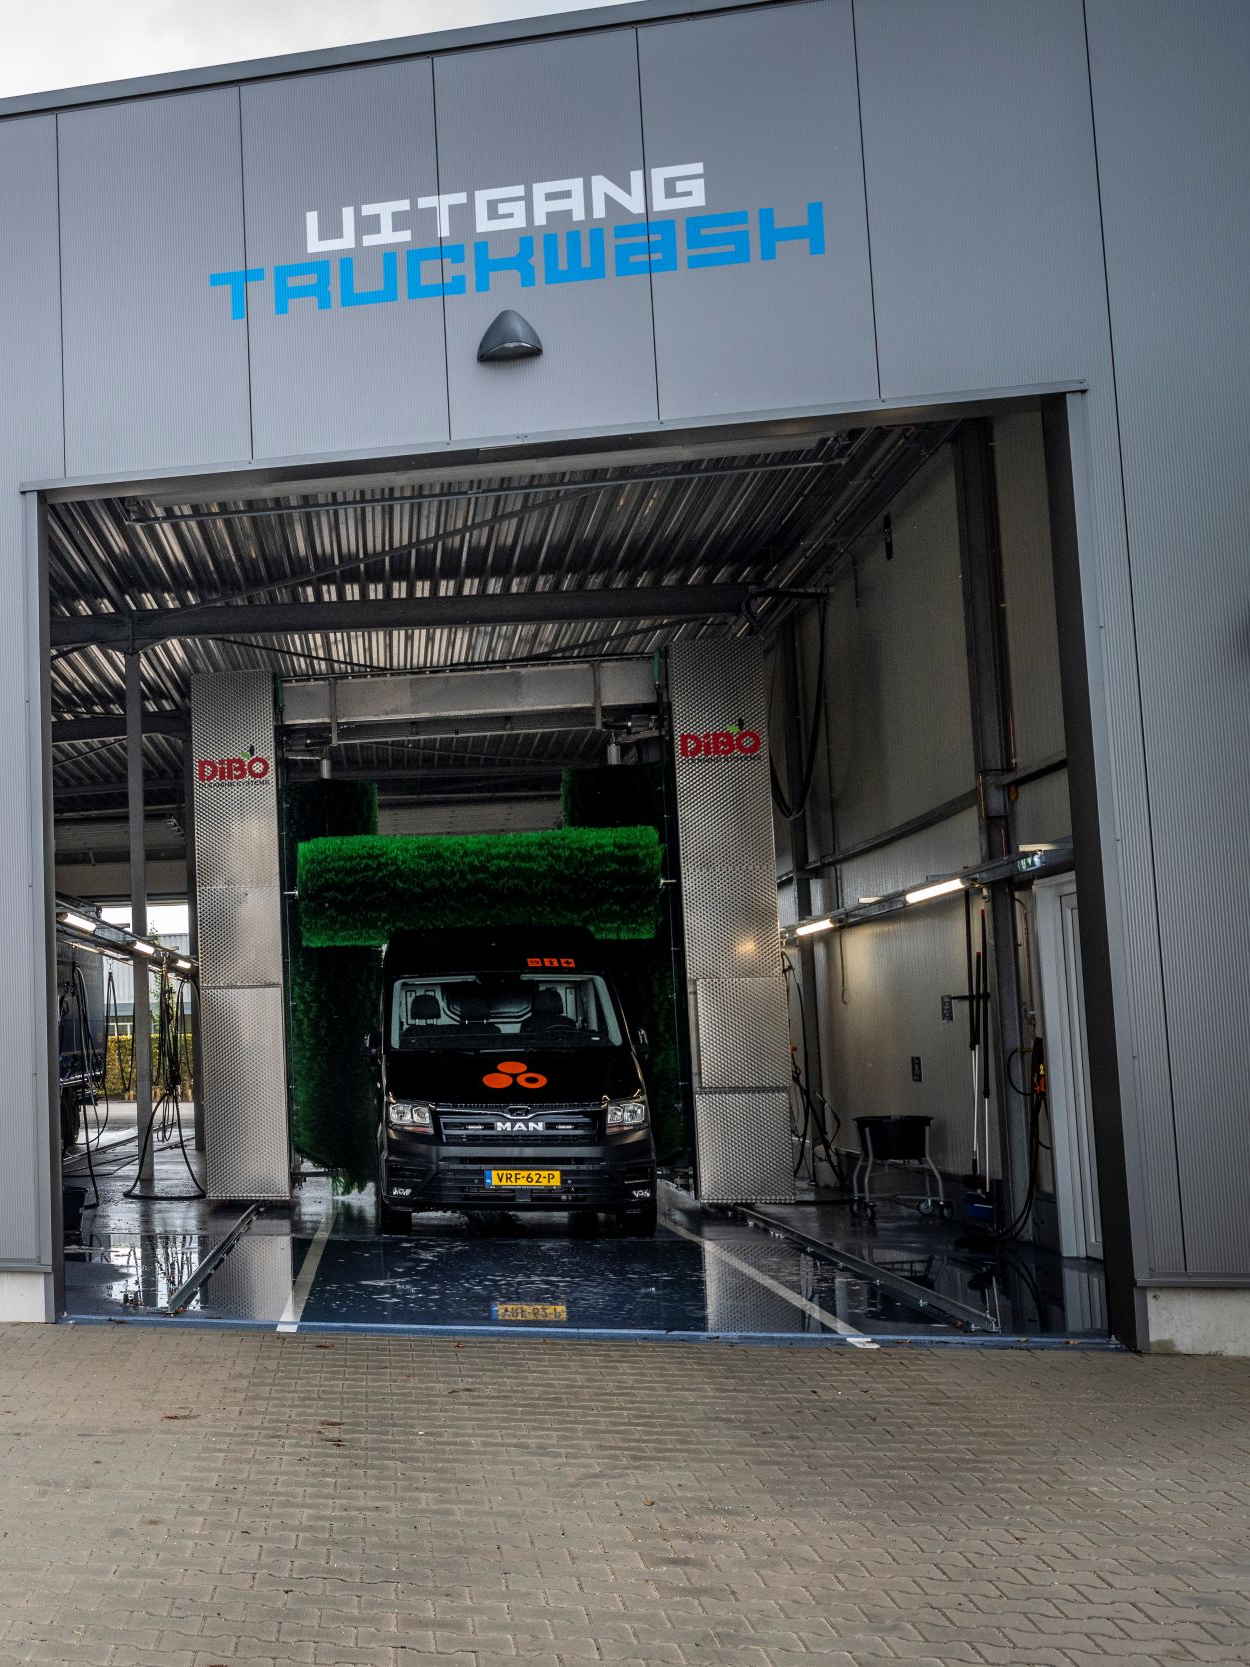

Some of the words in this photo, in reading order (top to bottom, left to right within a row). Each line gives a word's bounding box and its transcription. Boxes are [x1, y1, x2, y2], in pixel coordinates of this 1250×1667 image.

[306, 162, 706, 254] UITGANG
[496, 1121, 544, 1131] MAN
[496, 1172, 555, 1184] VRF-62-P
